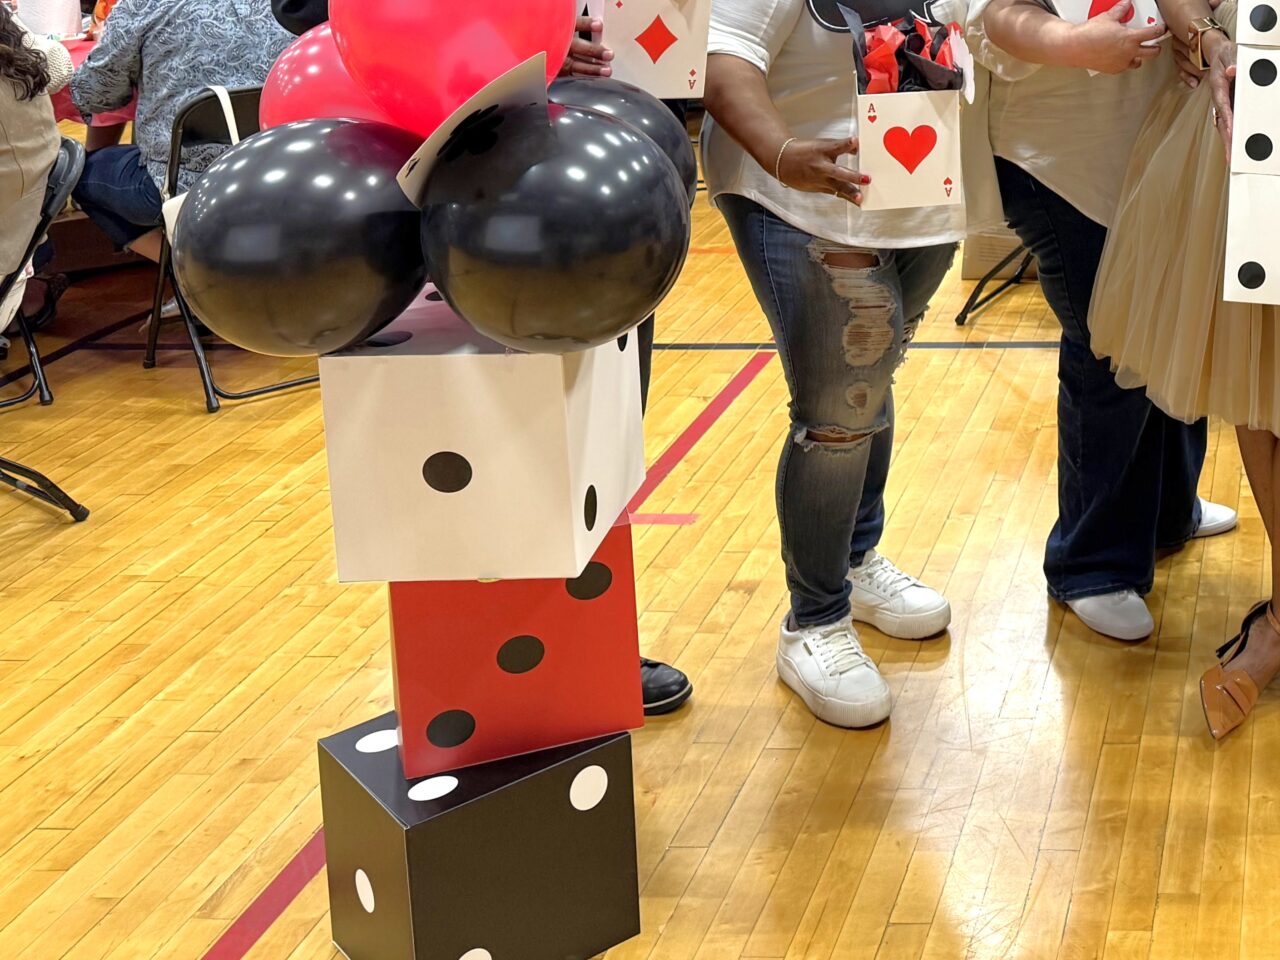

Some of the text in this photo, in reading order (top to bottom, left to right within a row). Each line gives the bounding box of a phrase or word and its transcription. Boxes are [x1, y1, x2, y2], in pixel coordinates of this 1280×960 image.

[688, 79, 697, 90] A
[867, 103, 876, 113] A
[944, 187, 953, 198] A
